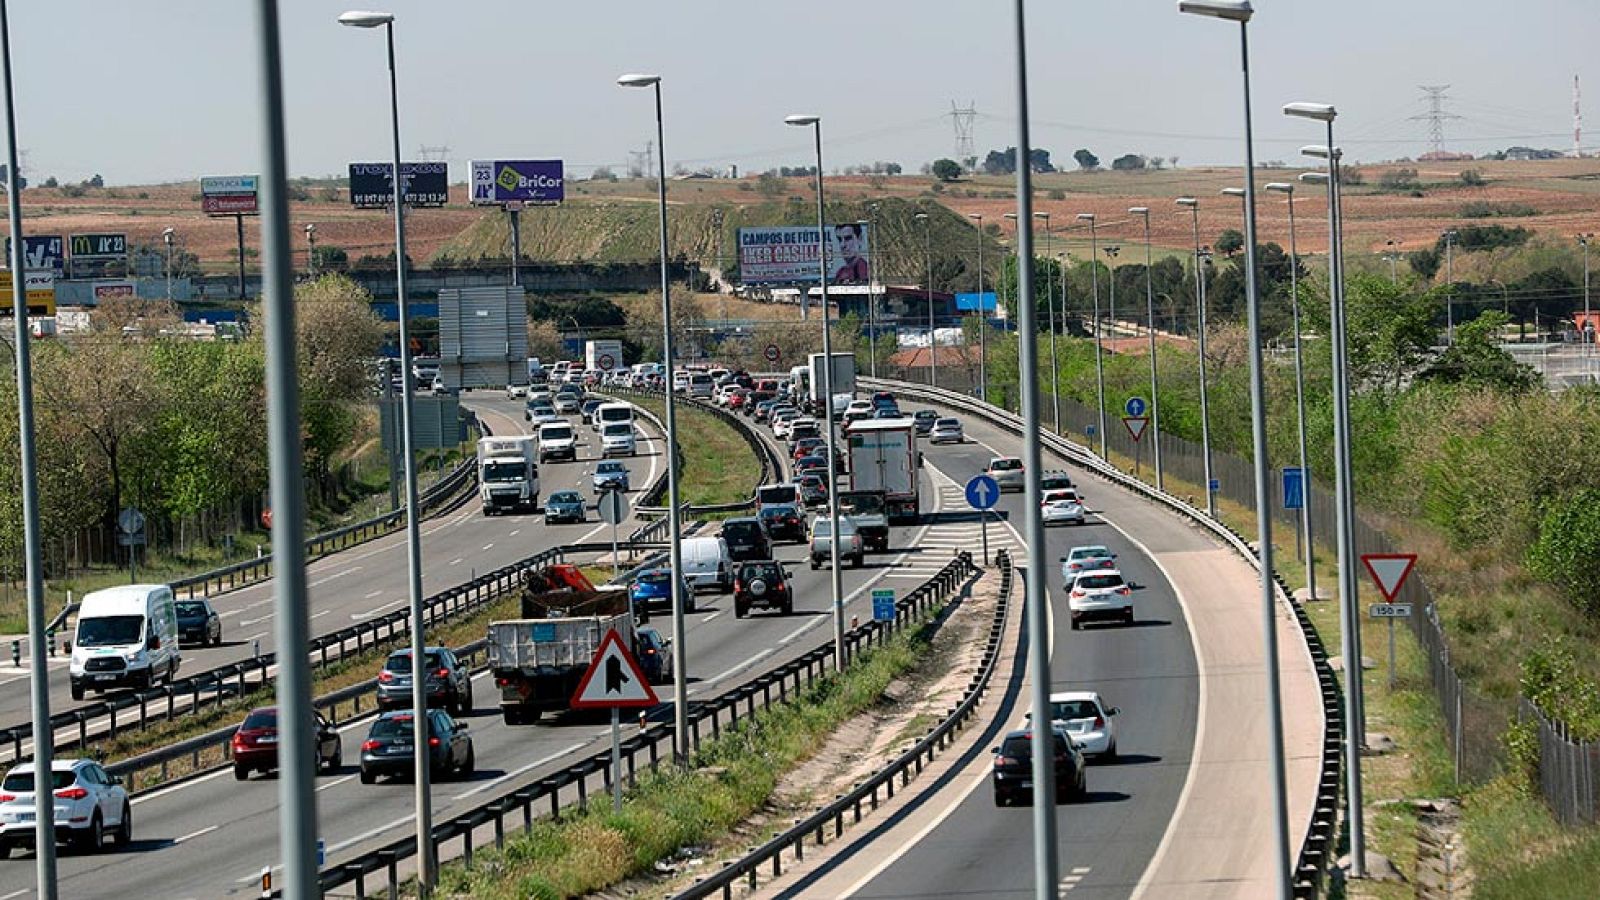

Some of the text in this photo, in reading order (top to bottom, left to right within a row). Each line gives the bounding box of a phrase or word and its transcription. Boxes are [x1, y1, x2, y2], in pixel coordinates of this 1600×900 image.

[476, 171, 490, 180] 23
[519, 175, 562, 187] BriCor
[743, 228, 832, 245] CAMPOS DE FÚTBL
[743, 244, 833, 264] IKER CASILLS
